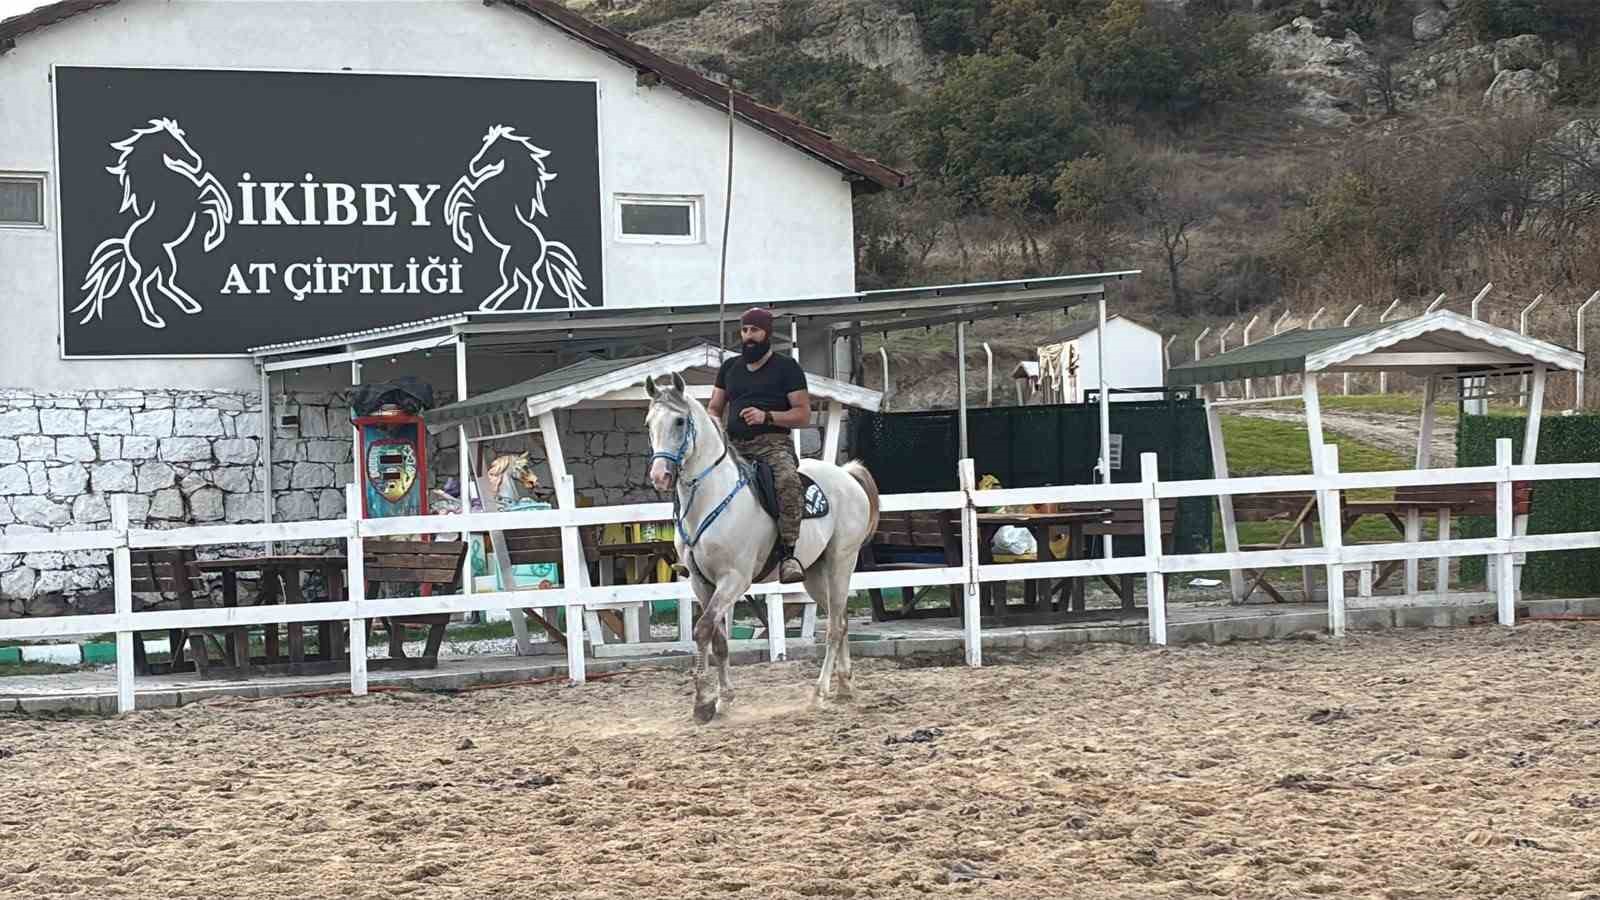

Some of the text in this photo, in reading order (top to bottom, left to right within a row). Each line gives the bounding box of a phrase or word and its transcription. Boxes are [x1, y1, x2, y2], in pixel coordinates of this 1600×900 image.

[237, 173, 441, 226] İKİBEY
[220, 256, 464, 302] AT ÇİFTLİĞİ
